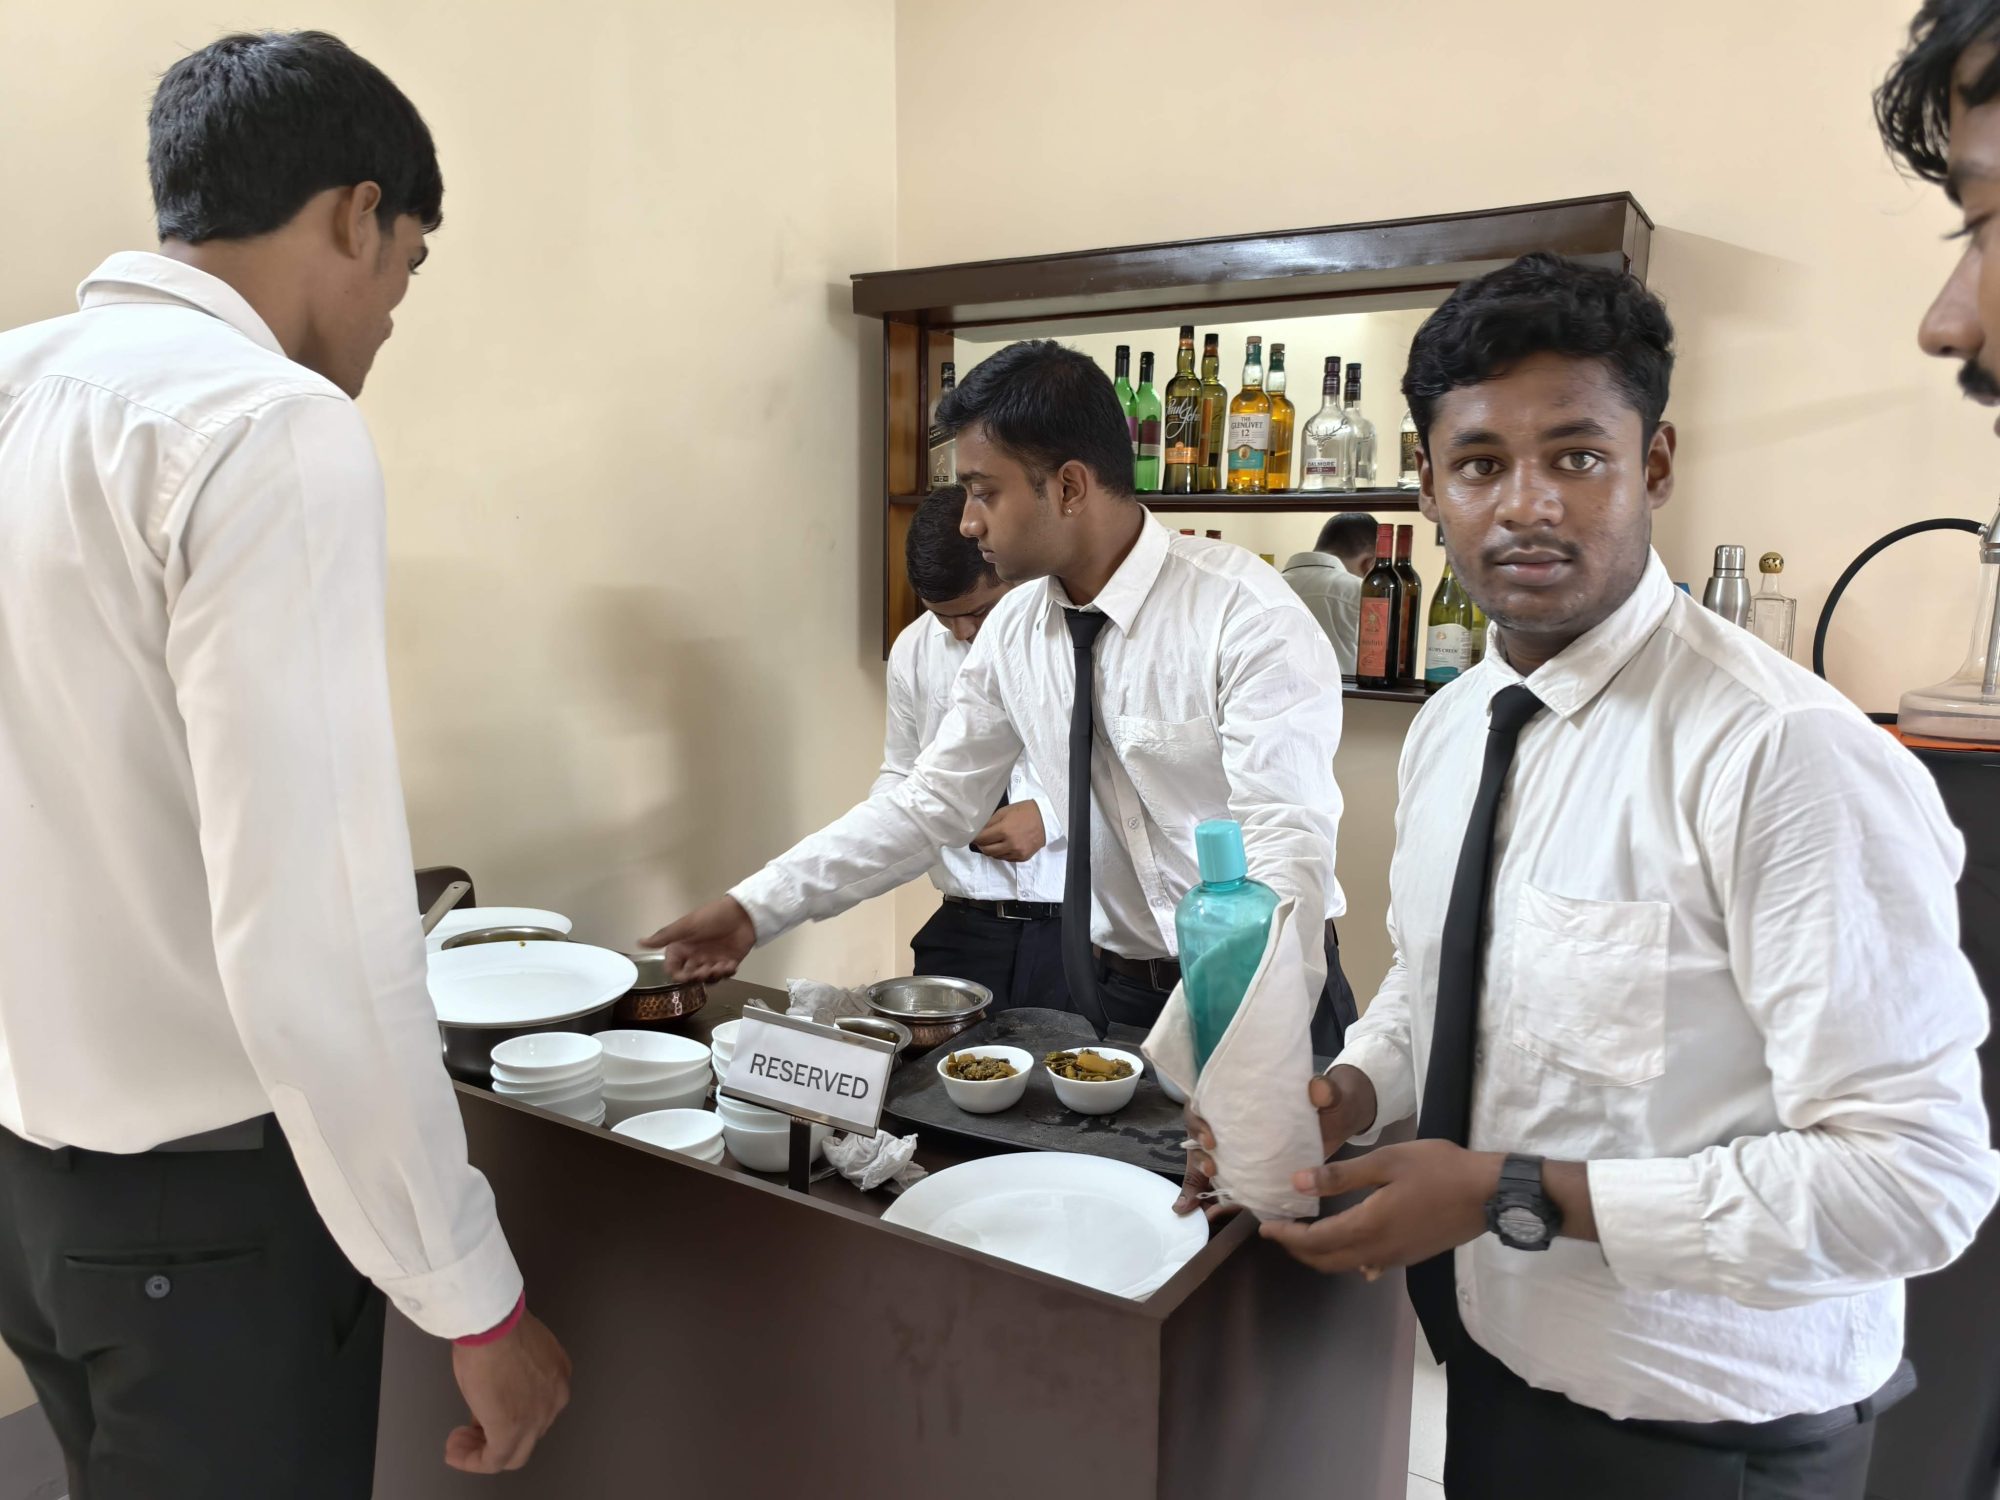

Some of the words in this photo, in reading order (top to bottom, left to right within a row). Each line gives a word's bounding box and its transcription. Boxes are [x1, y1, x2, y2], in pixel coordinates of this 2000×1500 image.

[1231, 421, 1264, 430] GLENLIVET
[1241, 429, 1250, 437] 12
[1403, 432, 1419, 443] ABE
[749, 1052, 869, 1100] RESERVED
